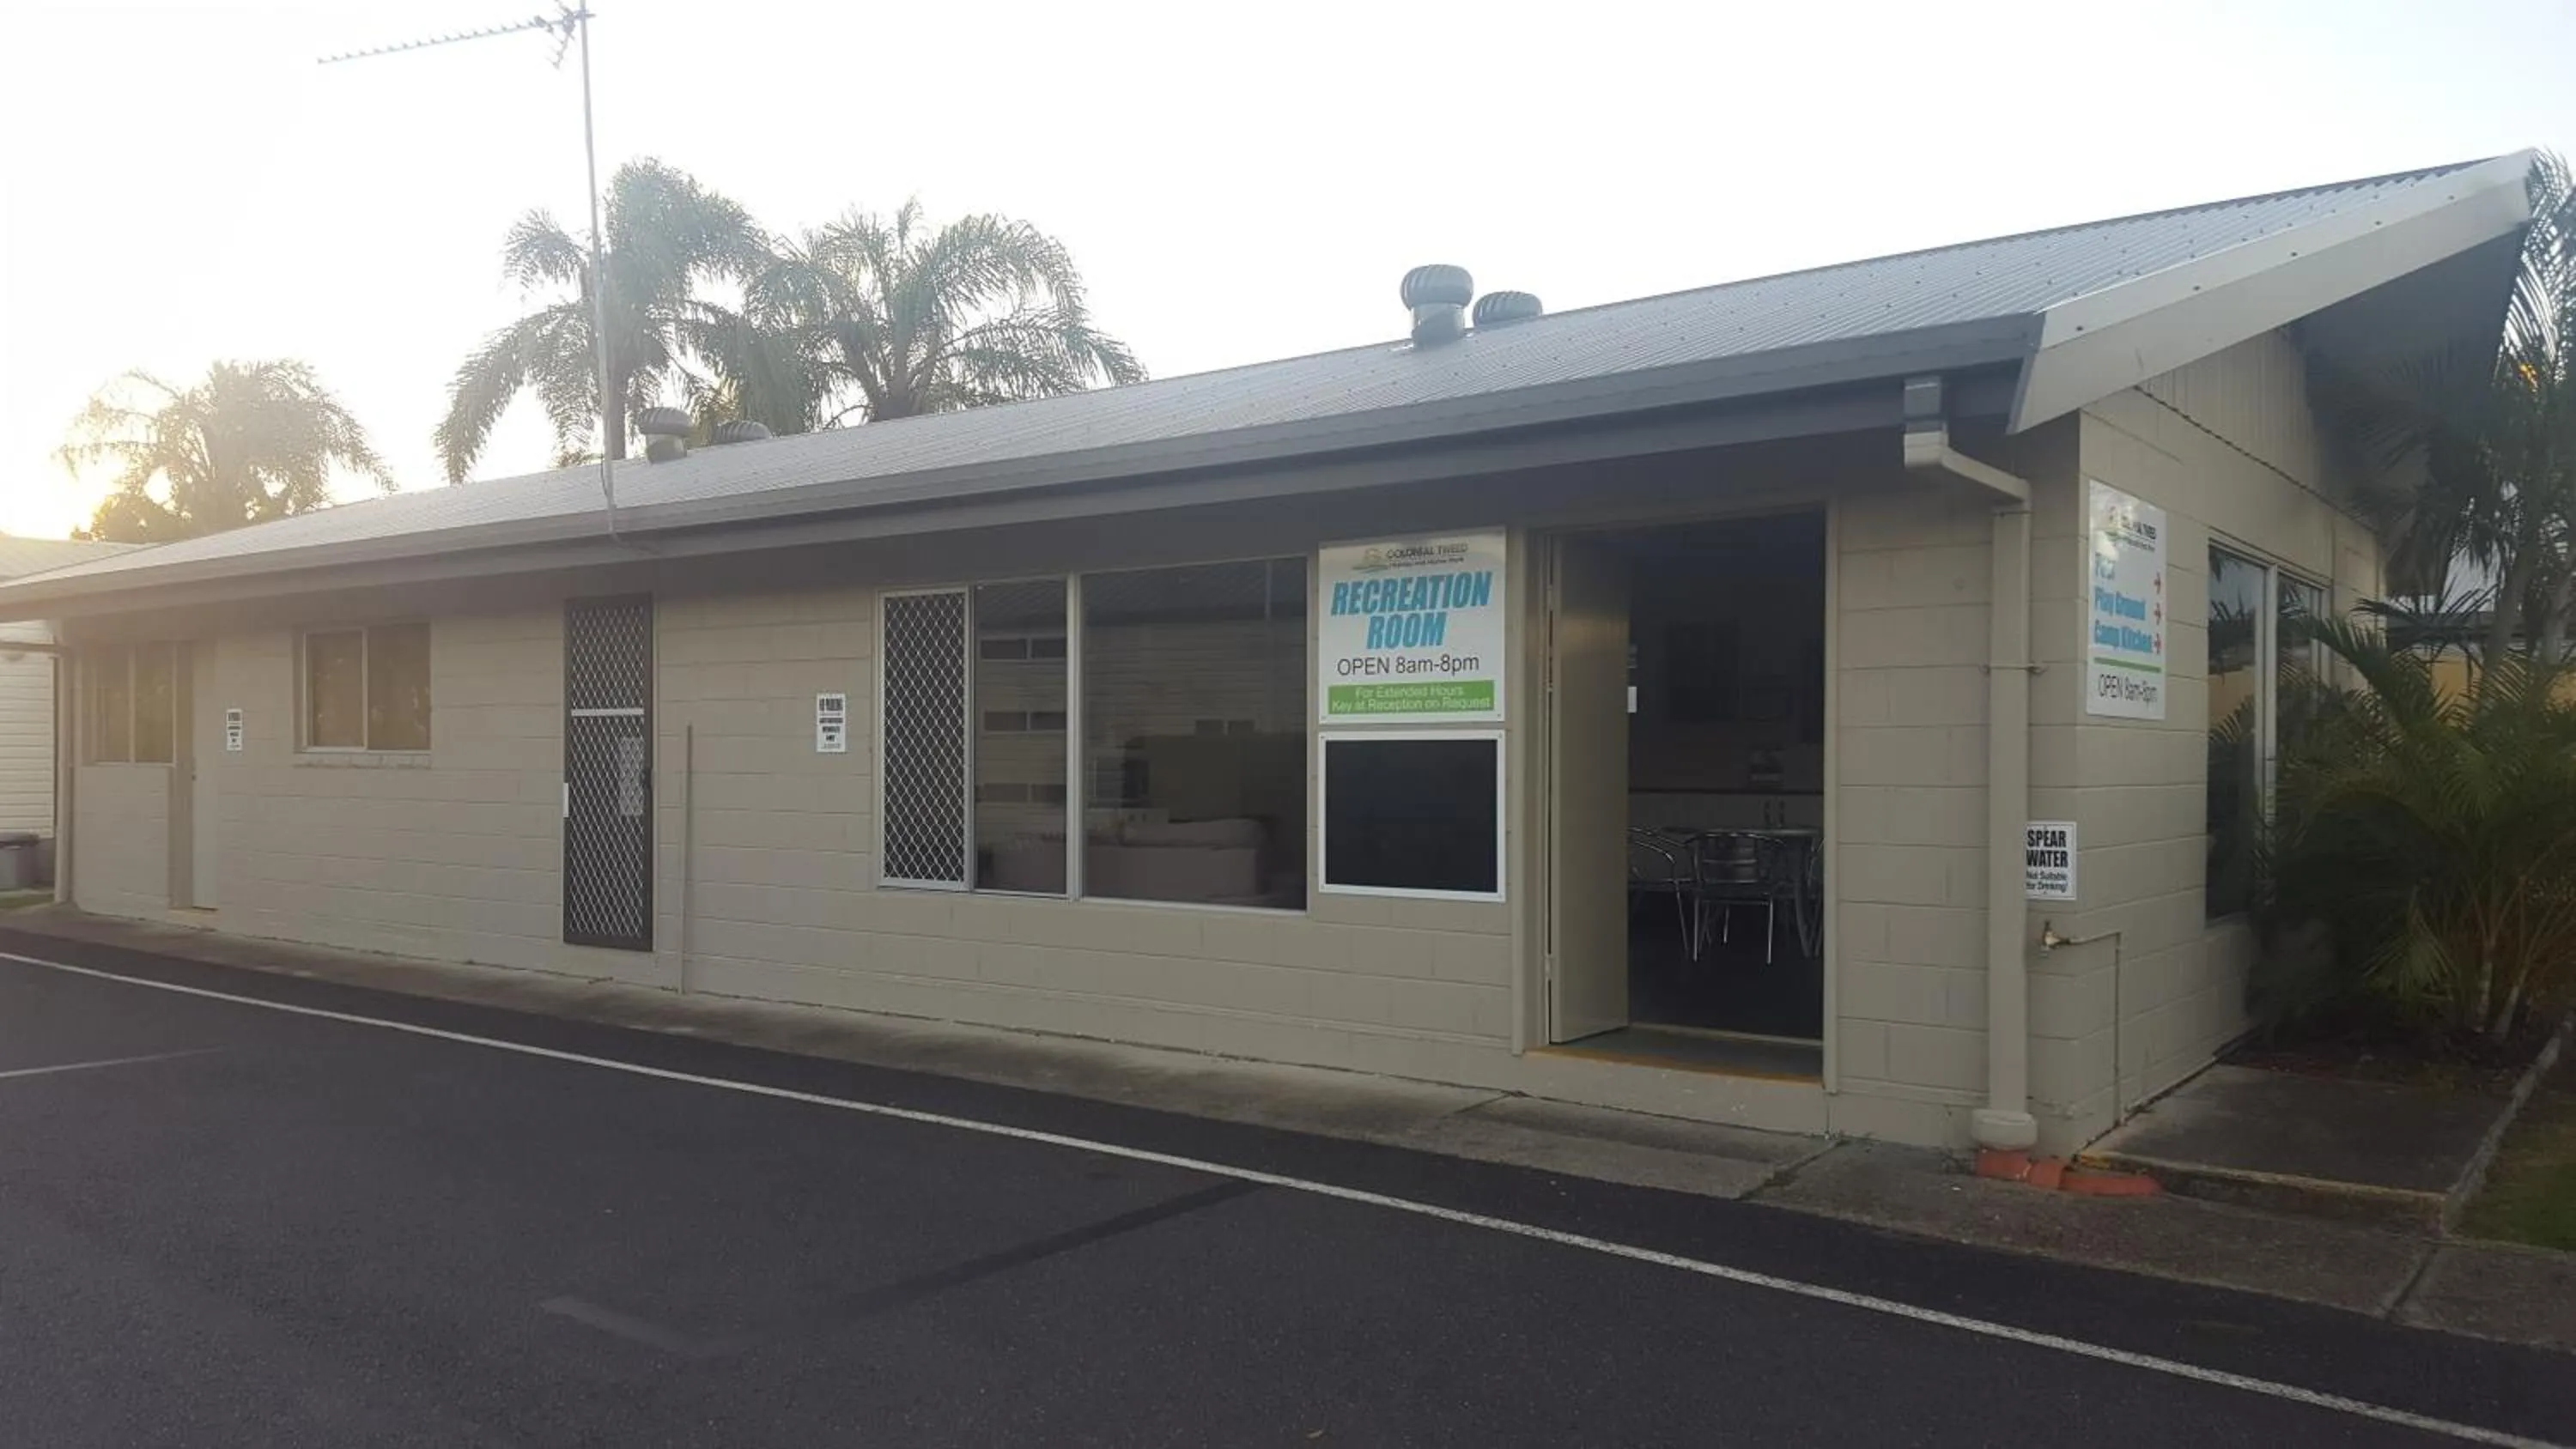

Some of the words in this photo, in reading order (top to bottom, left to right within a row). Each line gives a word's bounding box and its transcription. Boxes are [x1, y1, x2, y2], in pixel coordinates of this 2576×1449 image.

[1331, 571, 1492, 616] RECREATION
[1367, 611, 1448, 650] ROOM
[1337, 657, 1389, 676] OPEN
[1395, 654, 1479, 676] 8am-8pm
[1356, 686, 1374, 699] For
[1376, 685, 1427, 698] Extended
[1430, 684, 1464, 697] Hours
[2098, 673, 2123, 698] OPEN
[1332, 700, 1353, 712] Key
[1368, 698, 1423, 712] Reception
[1425, 700, 1441, 710] on
[1443, 695, 1491, 711] Request
[2027, 829, 2067, 848] SPEAR
[2026, 849, 2069, 868] WATER
